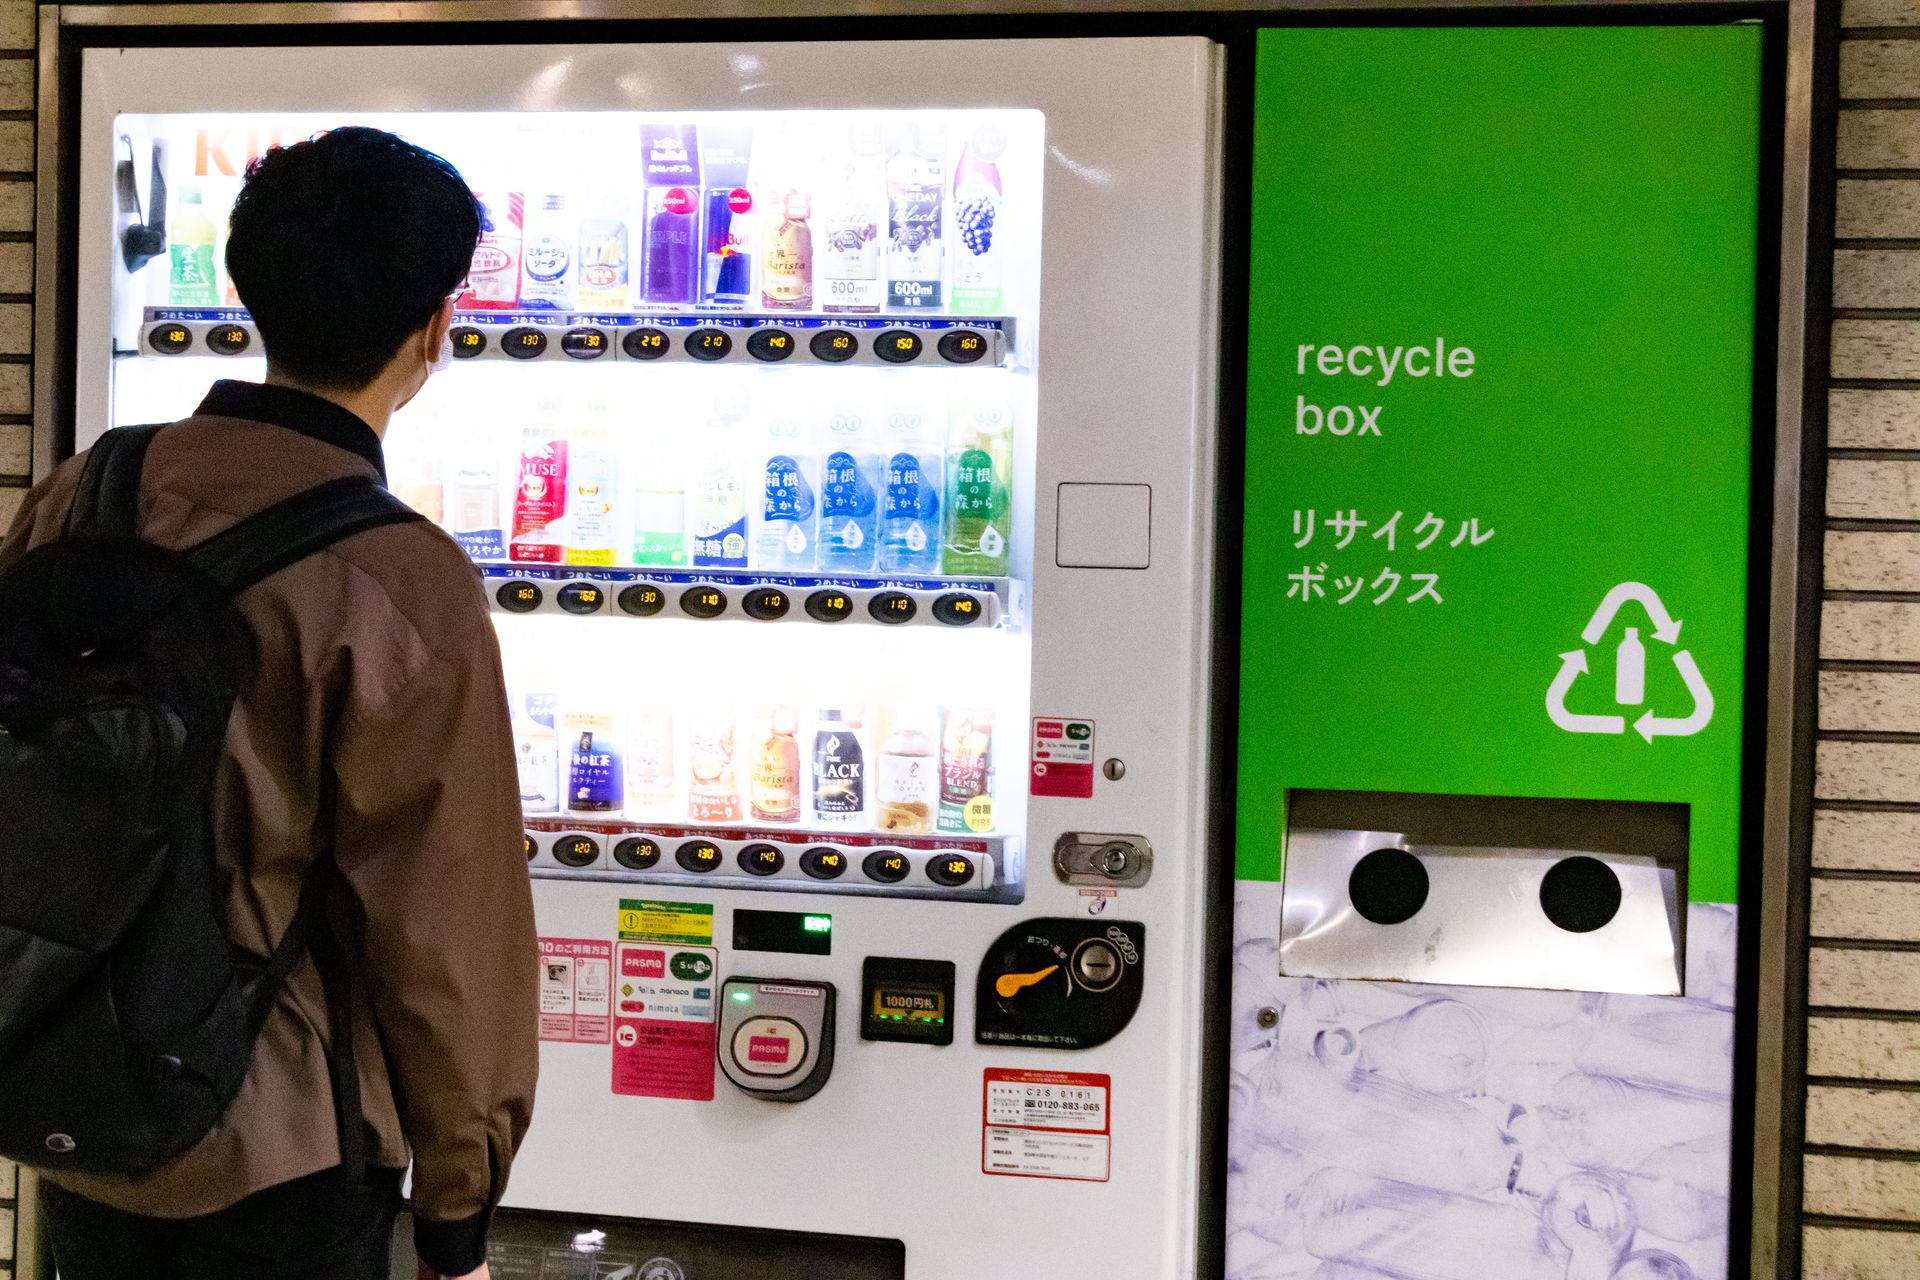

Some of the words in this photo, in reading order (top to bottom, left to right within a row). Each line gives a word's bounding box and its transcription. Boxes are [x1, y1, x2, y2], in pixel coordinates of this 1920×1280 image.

[768, 260, 806, 270] Barista
[831, 282, 868, 294] 600ml
[894, 282, 933, 294] 600ml
[227, 331, 243, 342] 130
[523, 335, 539, 345] 130
[641, 335, 661, 347] 210
[704, 336, 723, 347] 210
[833, 337, 849, 348] 160
[961, 338, 977, 349] 160
[1297, 336, 1476, 387] recycle
[1295, 395, 1383, 437] box
[519, 462, 559, 476] MUSE
[959, 466, 992, 483] 箱根
[766, 471, 799, 487] 箱根
[824, 468, 856, 483] 箱根
[887, 470, 919, 485] 箱根
[777, 489, 786, 497] の
[834, 485, 843, 493] の
[970, 486, 979, 494] の
[1293, 509, 1496, 551] リサイクル
[1286, 562, 1444, 606] ボックス
[516, 588, 534, 600] 160
[639, 591, 656, 603] 130
[764, 595, 781, 607] 110
[890, 599, 907, 610] 110
[572, 753, 611, 767] 後の紅茶
[813, 763, 861, 778] BLACK
[943, 767, 981, 780] ブラジル
[945, 779, 978, 789] BLEND
[574, 842, 591, 854] 120
[635, 844, 652, 856] 130
[758, 851, 776, 862] 140
[884, 858, 901, 869] 140
[625, 958, 662, 969] PASMO
[679, 961, 711, 973] Suica
[885, 995, 934, 1010] 1000円札
[620, 1033, 633, 1041] IC
[1037, 1100, 1100, 1112] 0120-883-065
